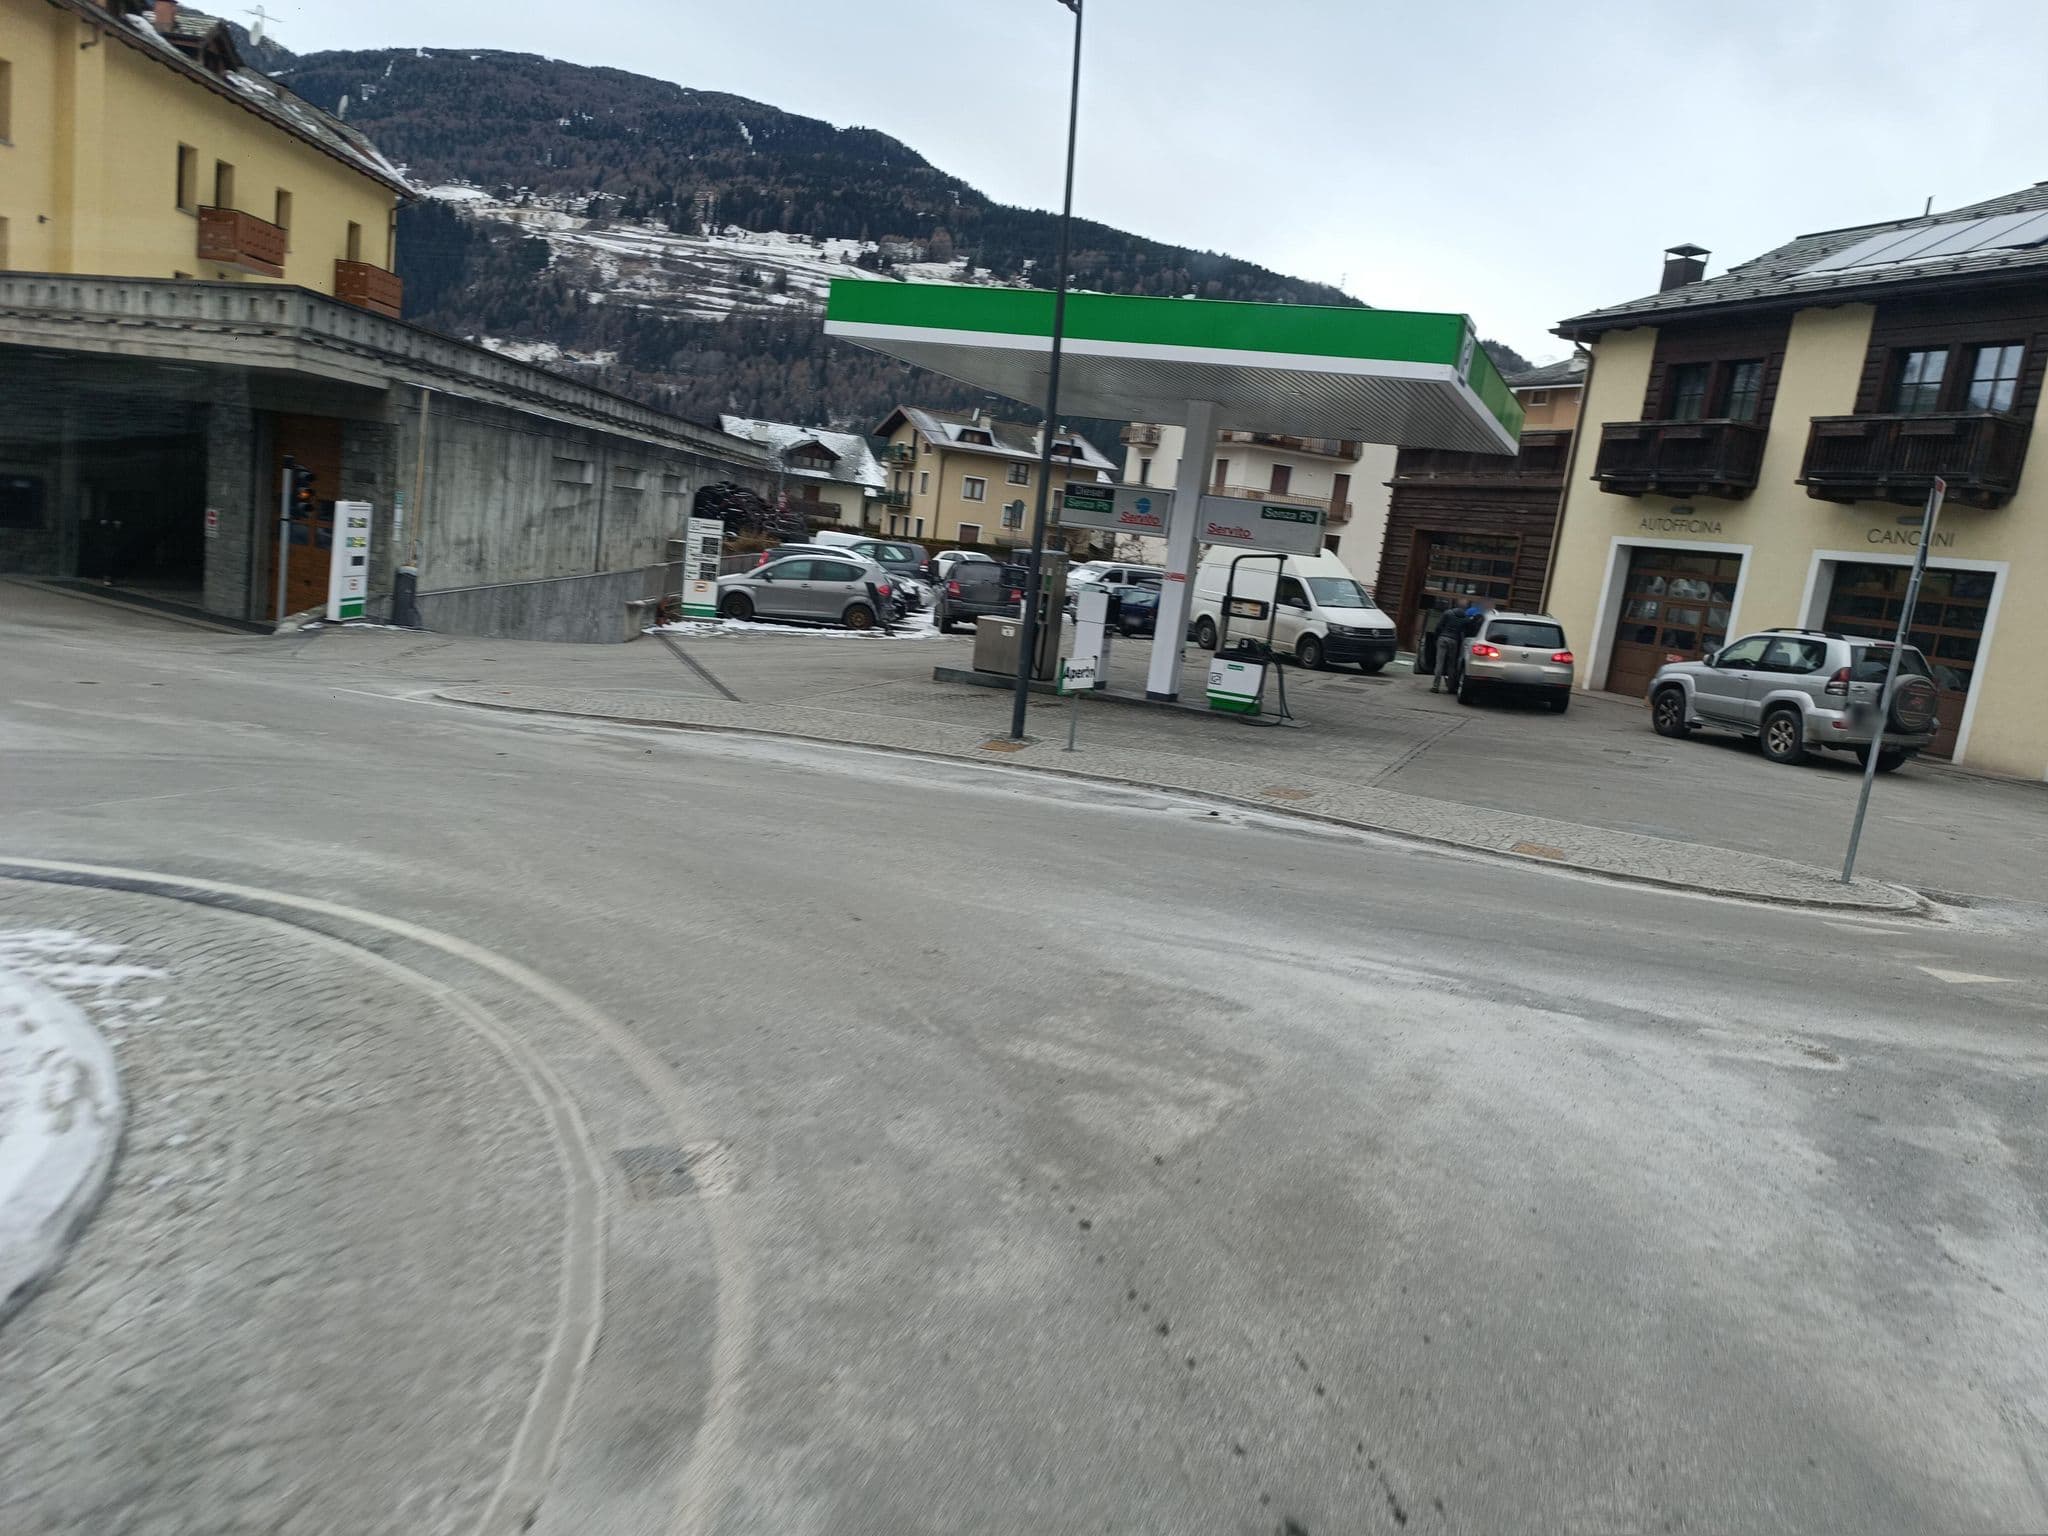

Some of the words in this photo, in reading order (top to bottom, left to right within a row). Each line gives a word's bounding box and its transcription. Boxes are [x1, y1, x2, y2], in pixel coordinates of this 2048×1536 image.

[1121, 511, 1161, 526] Servito
[1264, 507, 1297, 520] Senza
[1299, 511, 1315, 522] Pb
[1207, 522, 1253, 539] Servito
[1641, 517, 1722, 534] AUTOFFICINA
[1866, 528, 1956, 548] CANCINI
